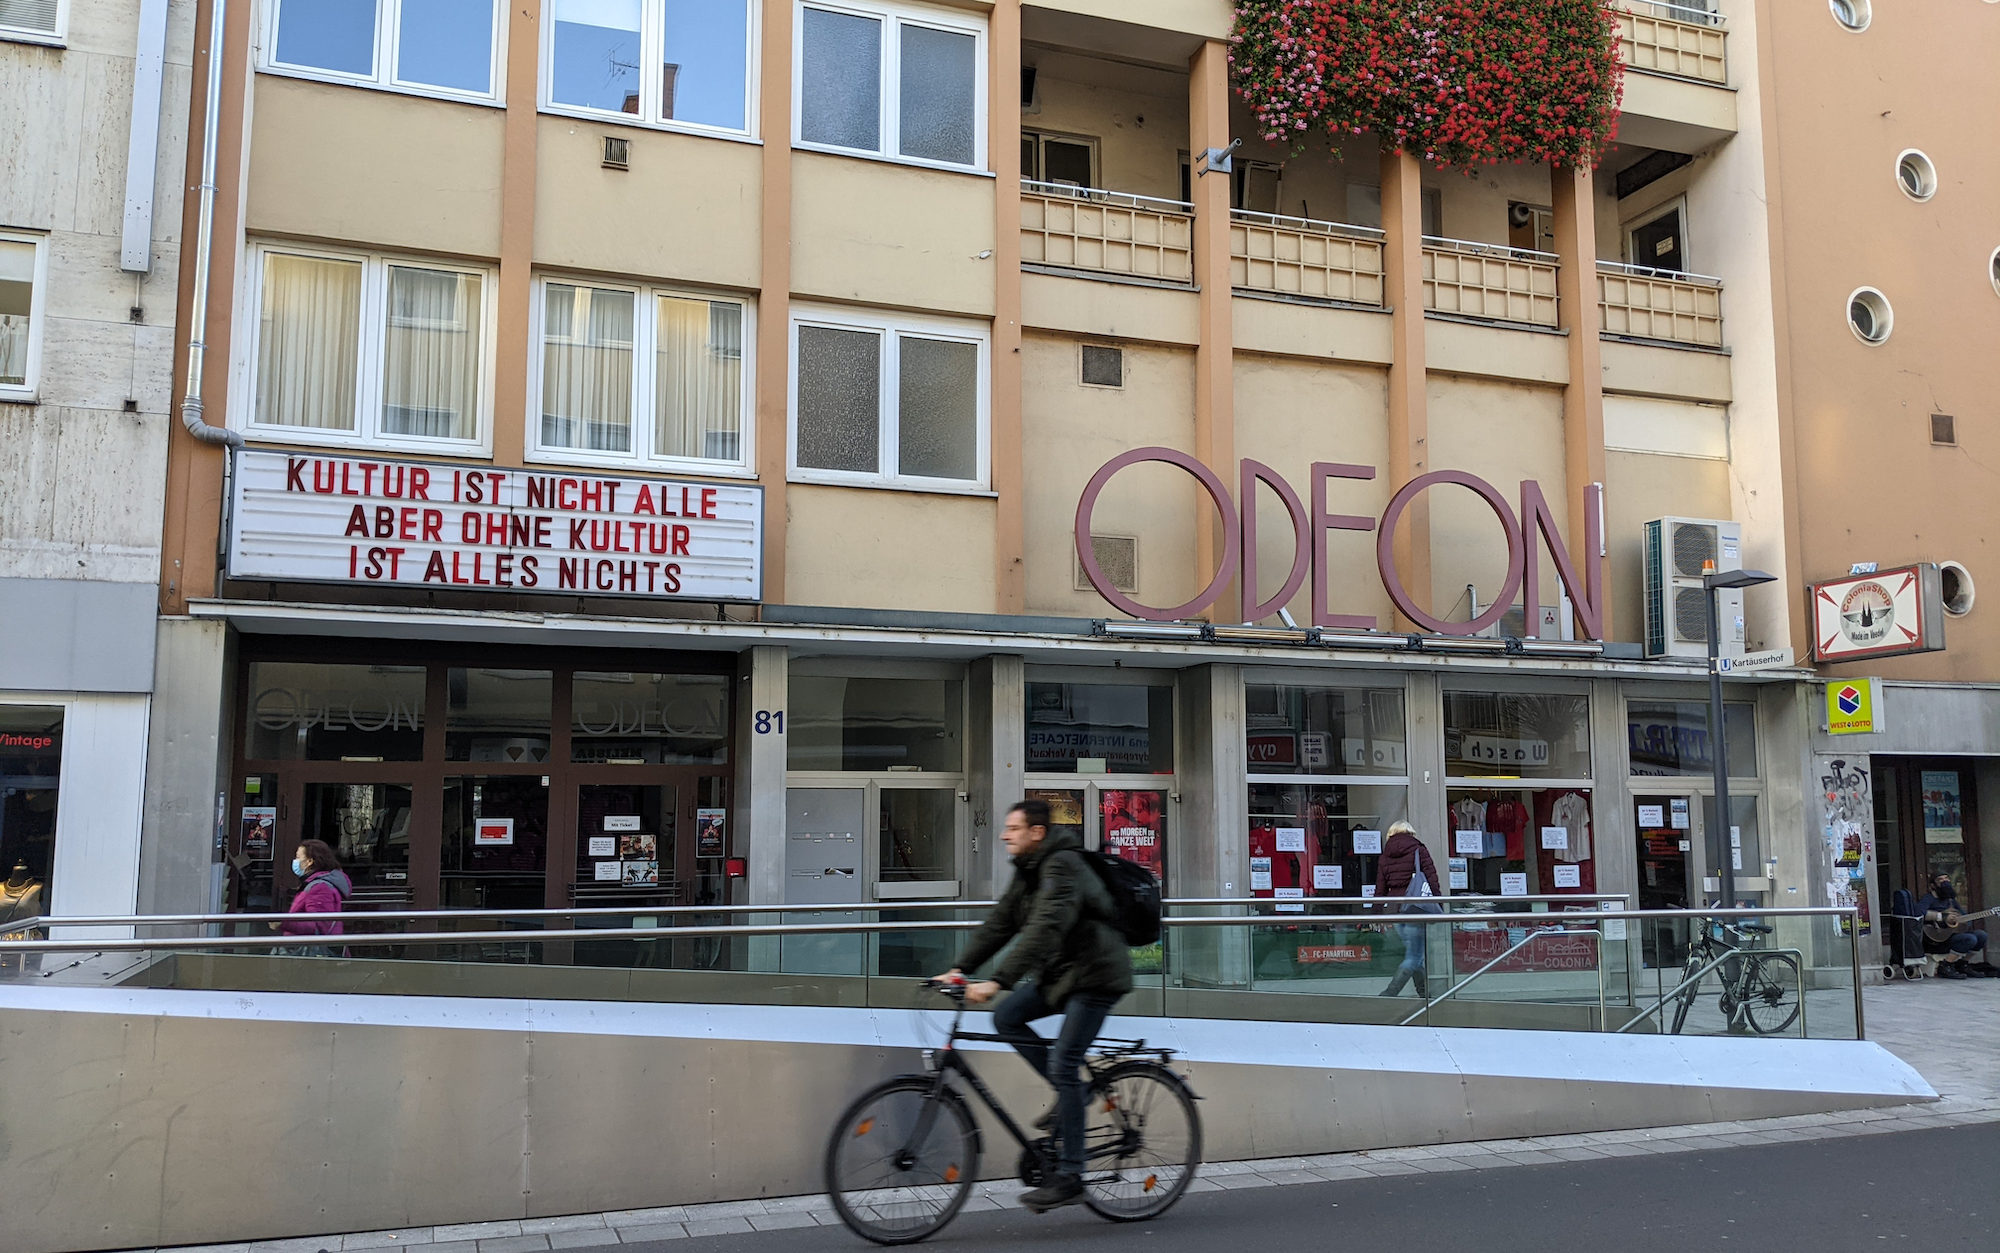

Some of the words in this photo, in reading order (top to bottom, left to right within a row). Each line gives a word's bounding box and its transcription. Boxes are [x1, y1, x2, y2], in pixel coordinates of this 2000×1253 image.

[287, 458, 430, 500] KULTUR
[453, 470, 506, 505] IST
[527, 476, 621, 512] NICHT
[633, 484, 717, 519] ALLE
[344, 504, 443, 542] ABER
[461, 511, 553, 548] OHNE
[569, 518, 690, 556] KULTUR
[1075, 446, 1602, 640] ODEON
[349, 545, 405, 580] IST
[423, 550, 539, 586] ALLES
[559, 557, 681, 593] NICHTS
[1842, 584, 1891, 613] ColoniaShop
[1851, 631, 1863, 641] Made
[1863, 631, 1870, 640] im
[1870, 628, 1884, 639] Veedel
[1732, 653, 1784, 668] Kartäuserhof
[754, 710, 785, 735] 81
[1830, 721, 1847, 729] WEST
[1851, 720, 1871, 728] LOTTO
[1120, 827, 1148, 837] MORGEN
[1110, 836, 1135, 846] GANZE
[1135, 836, 1156, 846] WELT
[1312, 949, 1356, 958] FC-FANARTIKEL
[1544, 956, 1592, 968] COLONIA
